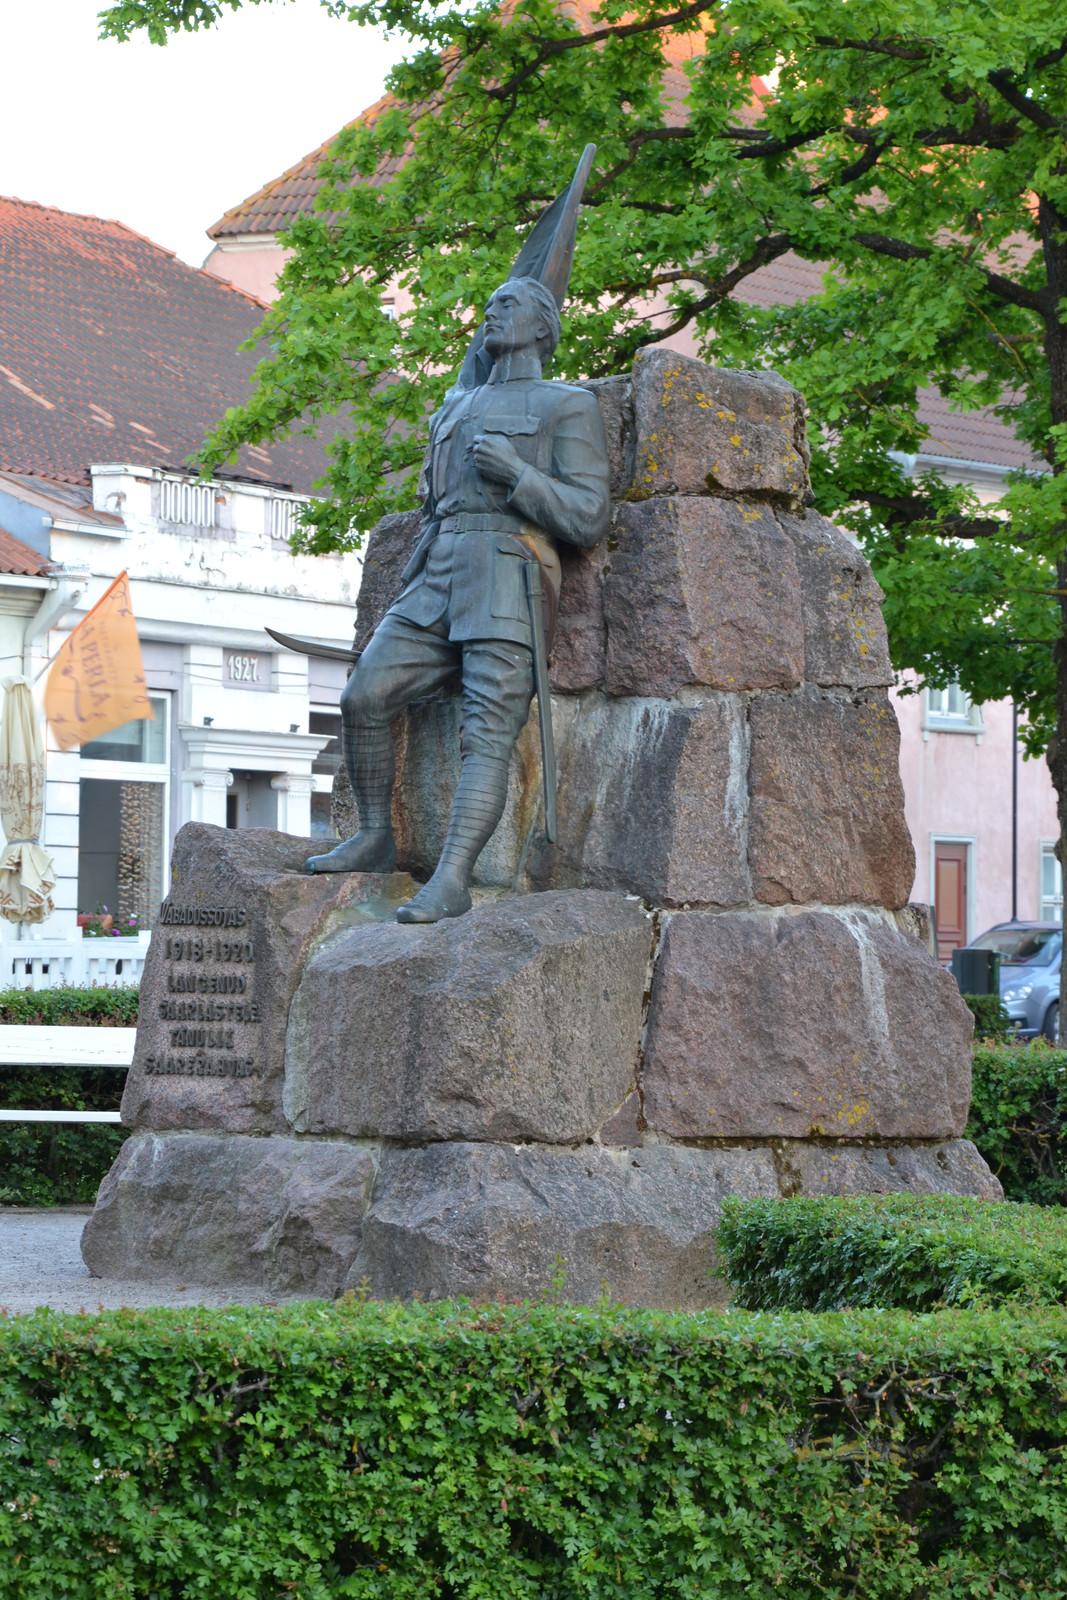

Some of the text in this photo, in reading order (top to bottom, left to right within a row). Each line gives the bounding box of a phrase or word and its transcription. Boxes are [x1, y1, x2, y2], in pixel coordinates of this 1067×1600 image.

[165, 938, 255, 963] 1918-1920
[168, 974, 247, 994] LANGENUD
[159, 1000, 262, 1024] SAARLASTELE
